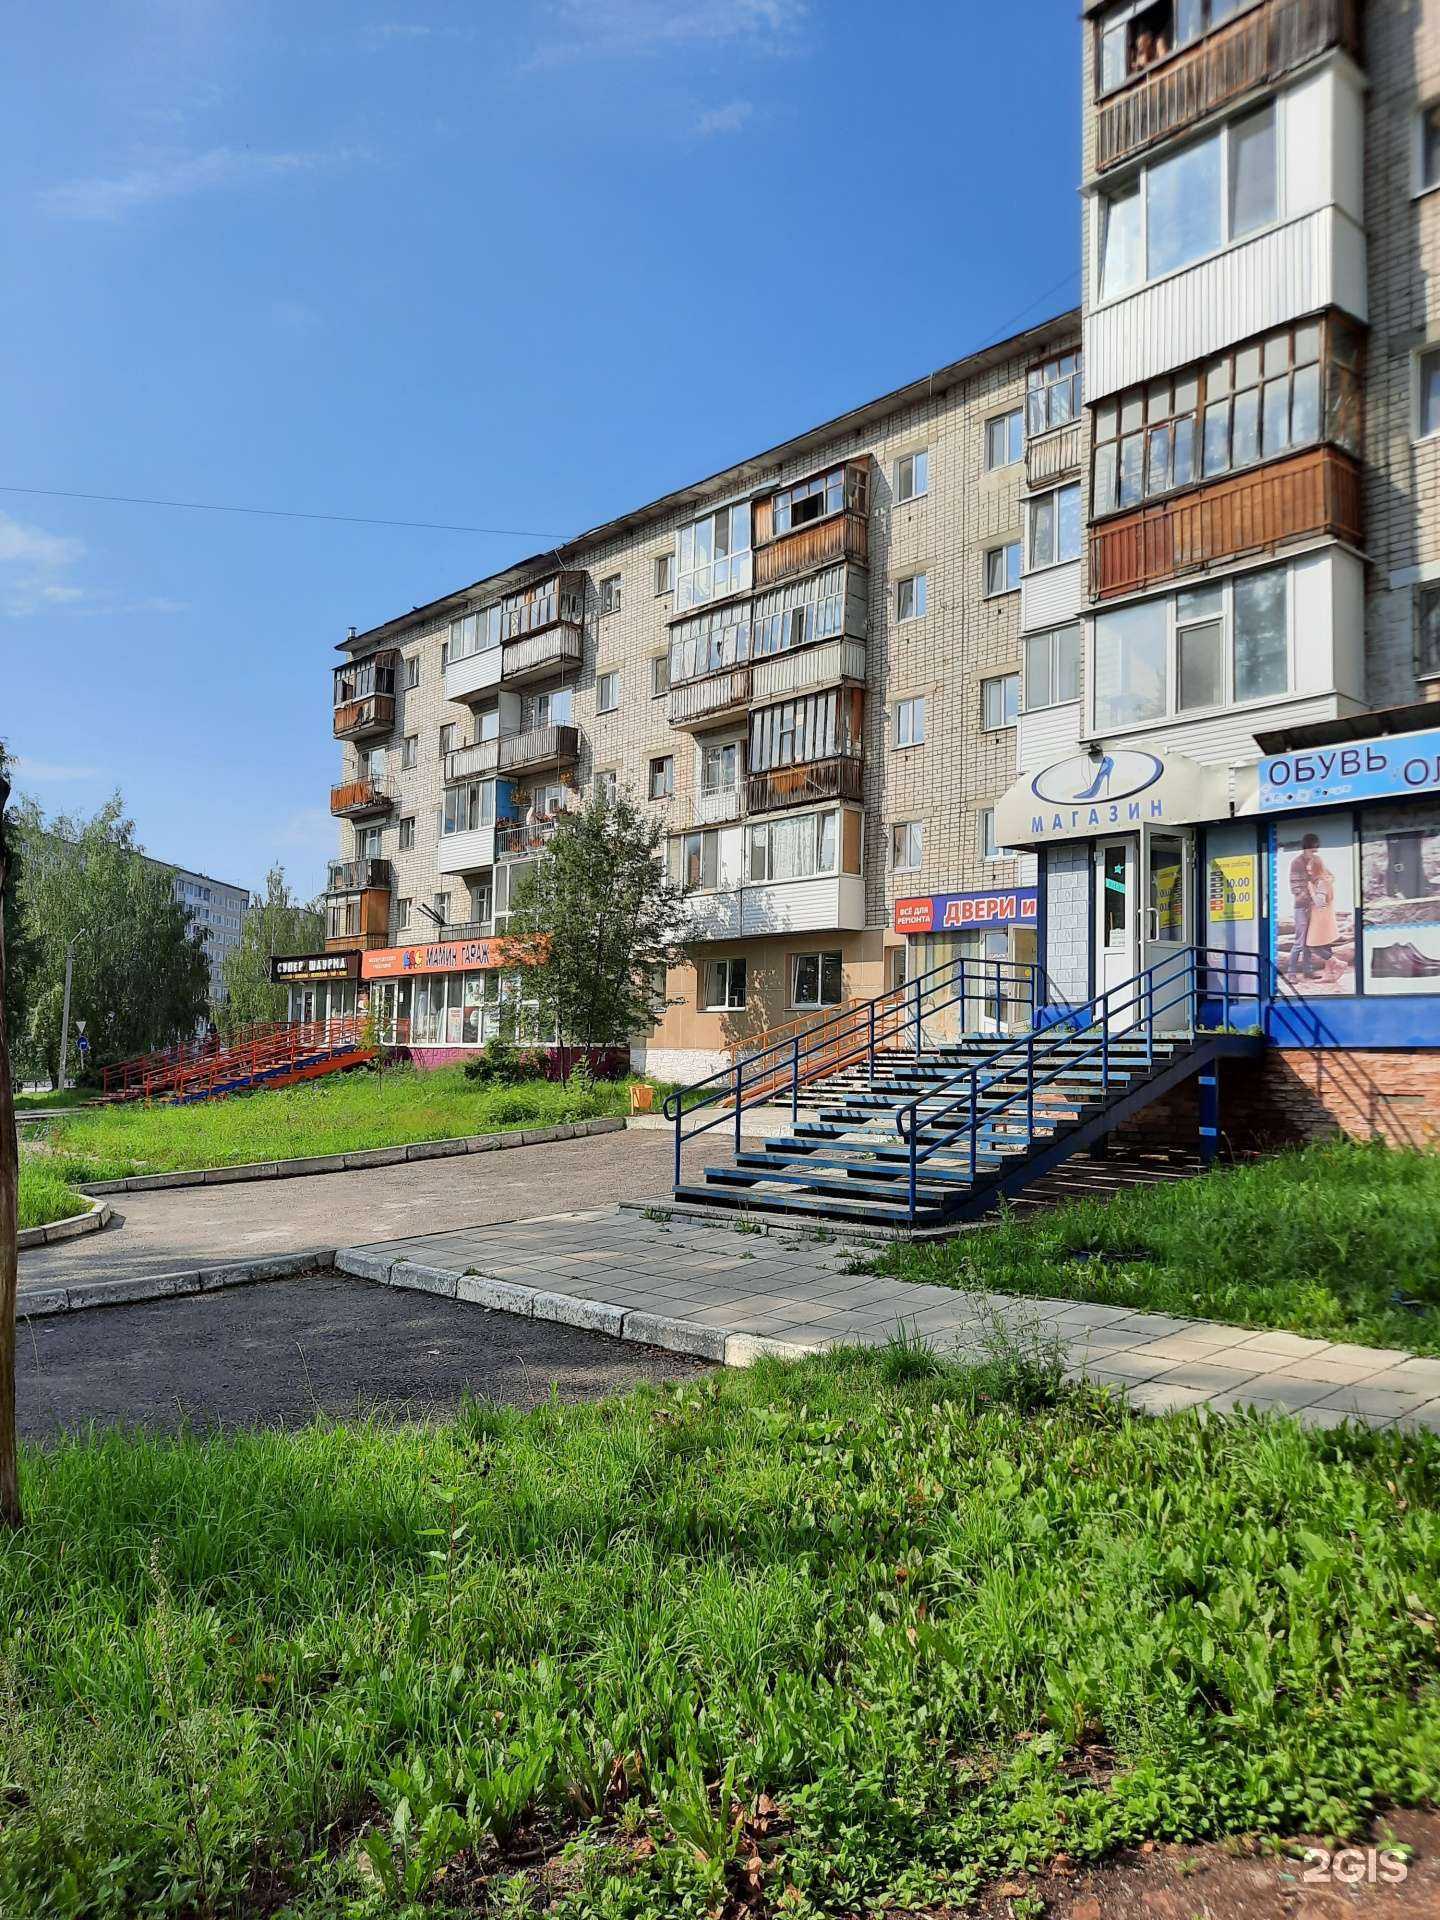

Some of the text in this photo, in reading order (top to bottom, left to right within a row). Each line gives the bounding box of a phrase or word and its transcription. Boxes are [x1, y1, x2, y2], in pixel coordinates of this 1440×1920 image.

[1269, 746, 1388, 787] ОБУВЬ
[1031, 799, 1163, 833] МАГАЗИН
[897, 915, 931, 925] РЕМОНТА
[944, 895, 1017, 928] ДВЕРИ
[277, 957, 347, 973] СУПЕР ШАУРМА
[461, 943, 490, 965] ГАРАЖ
